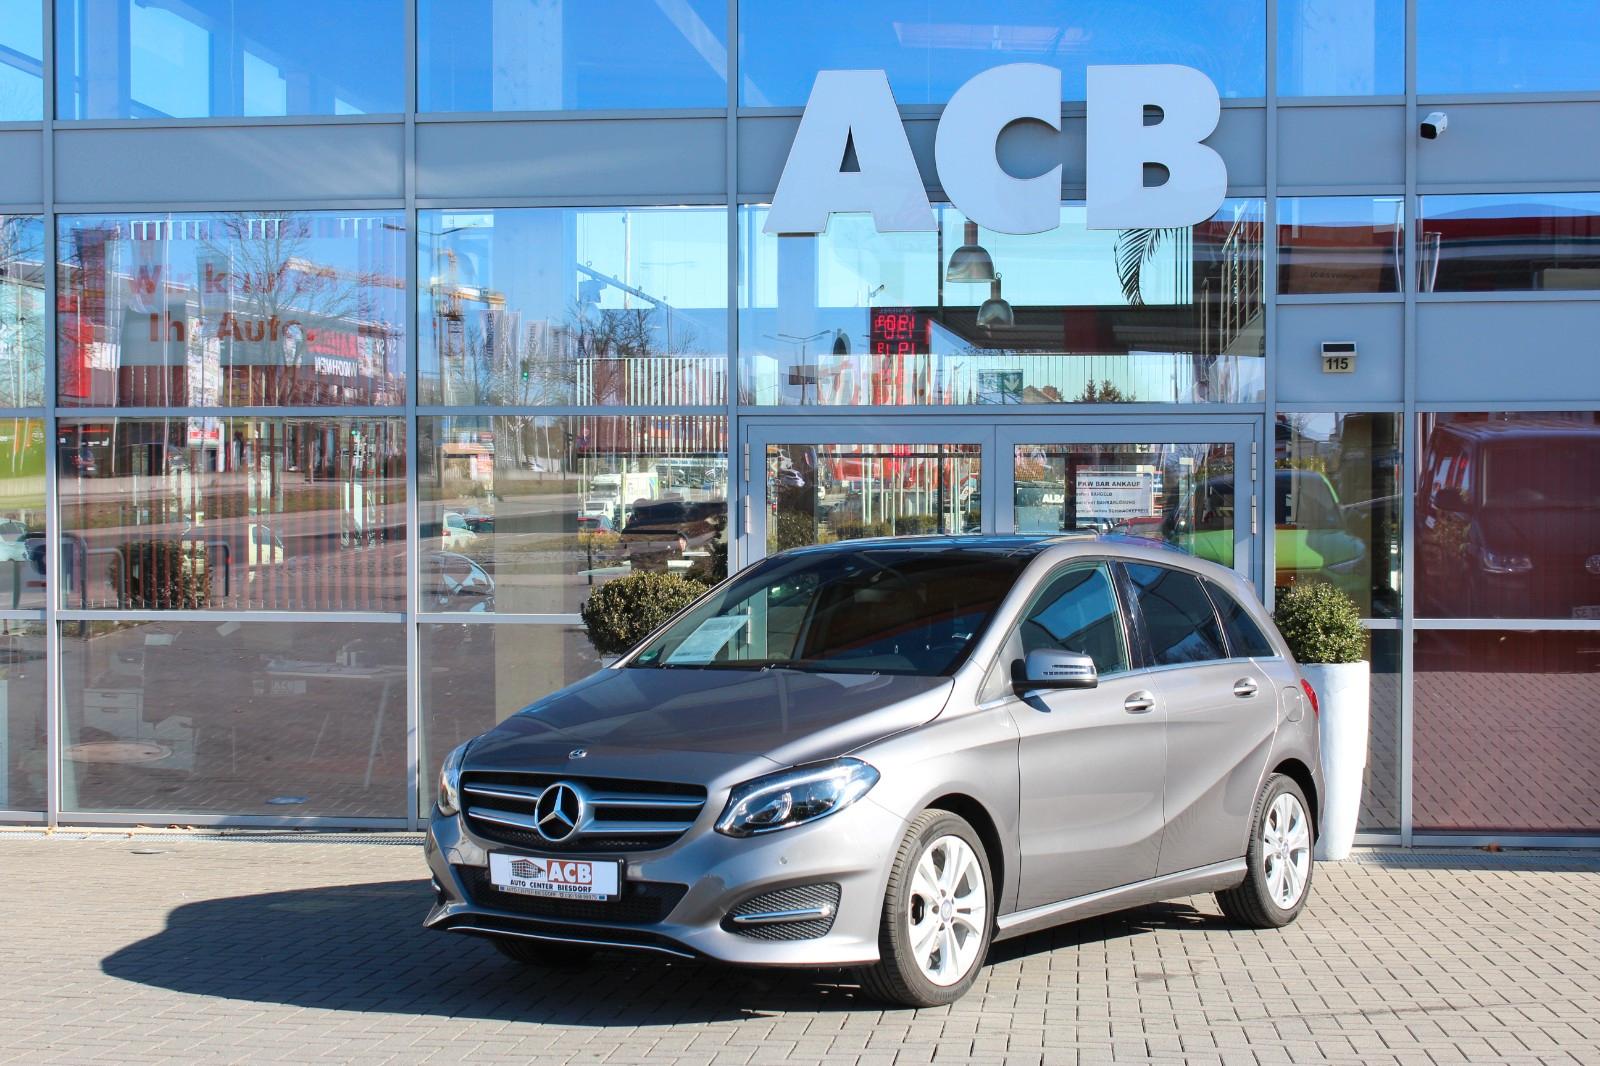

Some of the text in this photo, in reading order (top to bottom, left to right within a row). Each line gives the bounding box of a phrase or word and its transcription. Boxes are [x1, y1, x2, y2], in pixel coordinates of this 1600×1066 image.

[763, 62, 1228, 235] ACB
[1326, 357, 1349, 370] 115
[549, 862, 592, 883] ACB
[530, 881, 553, 890] CENTER
[557, 884, 592, 893] BIESDORF
